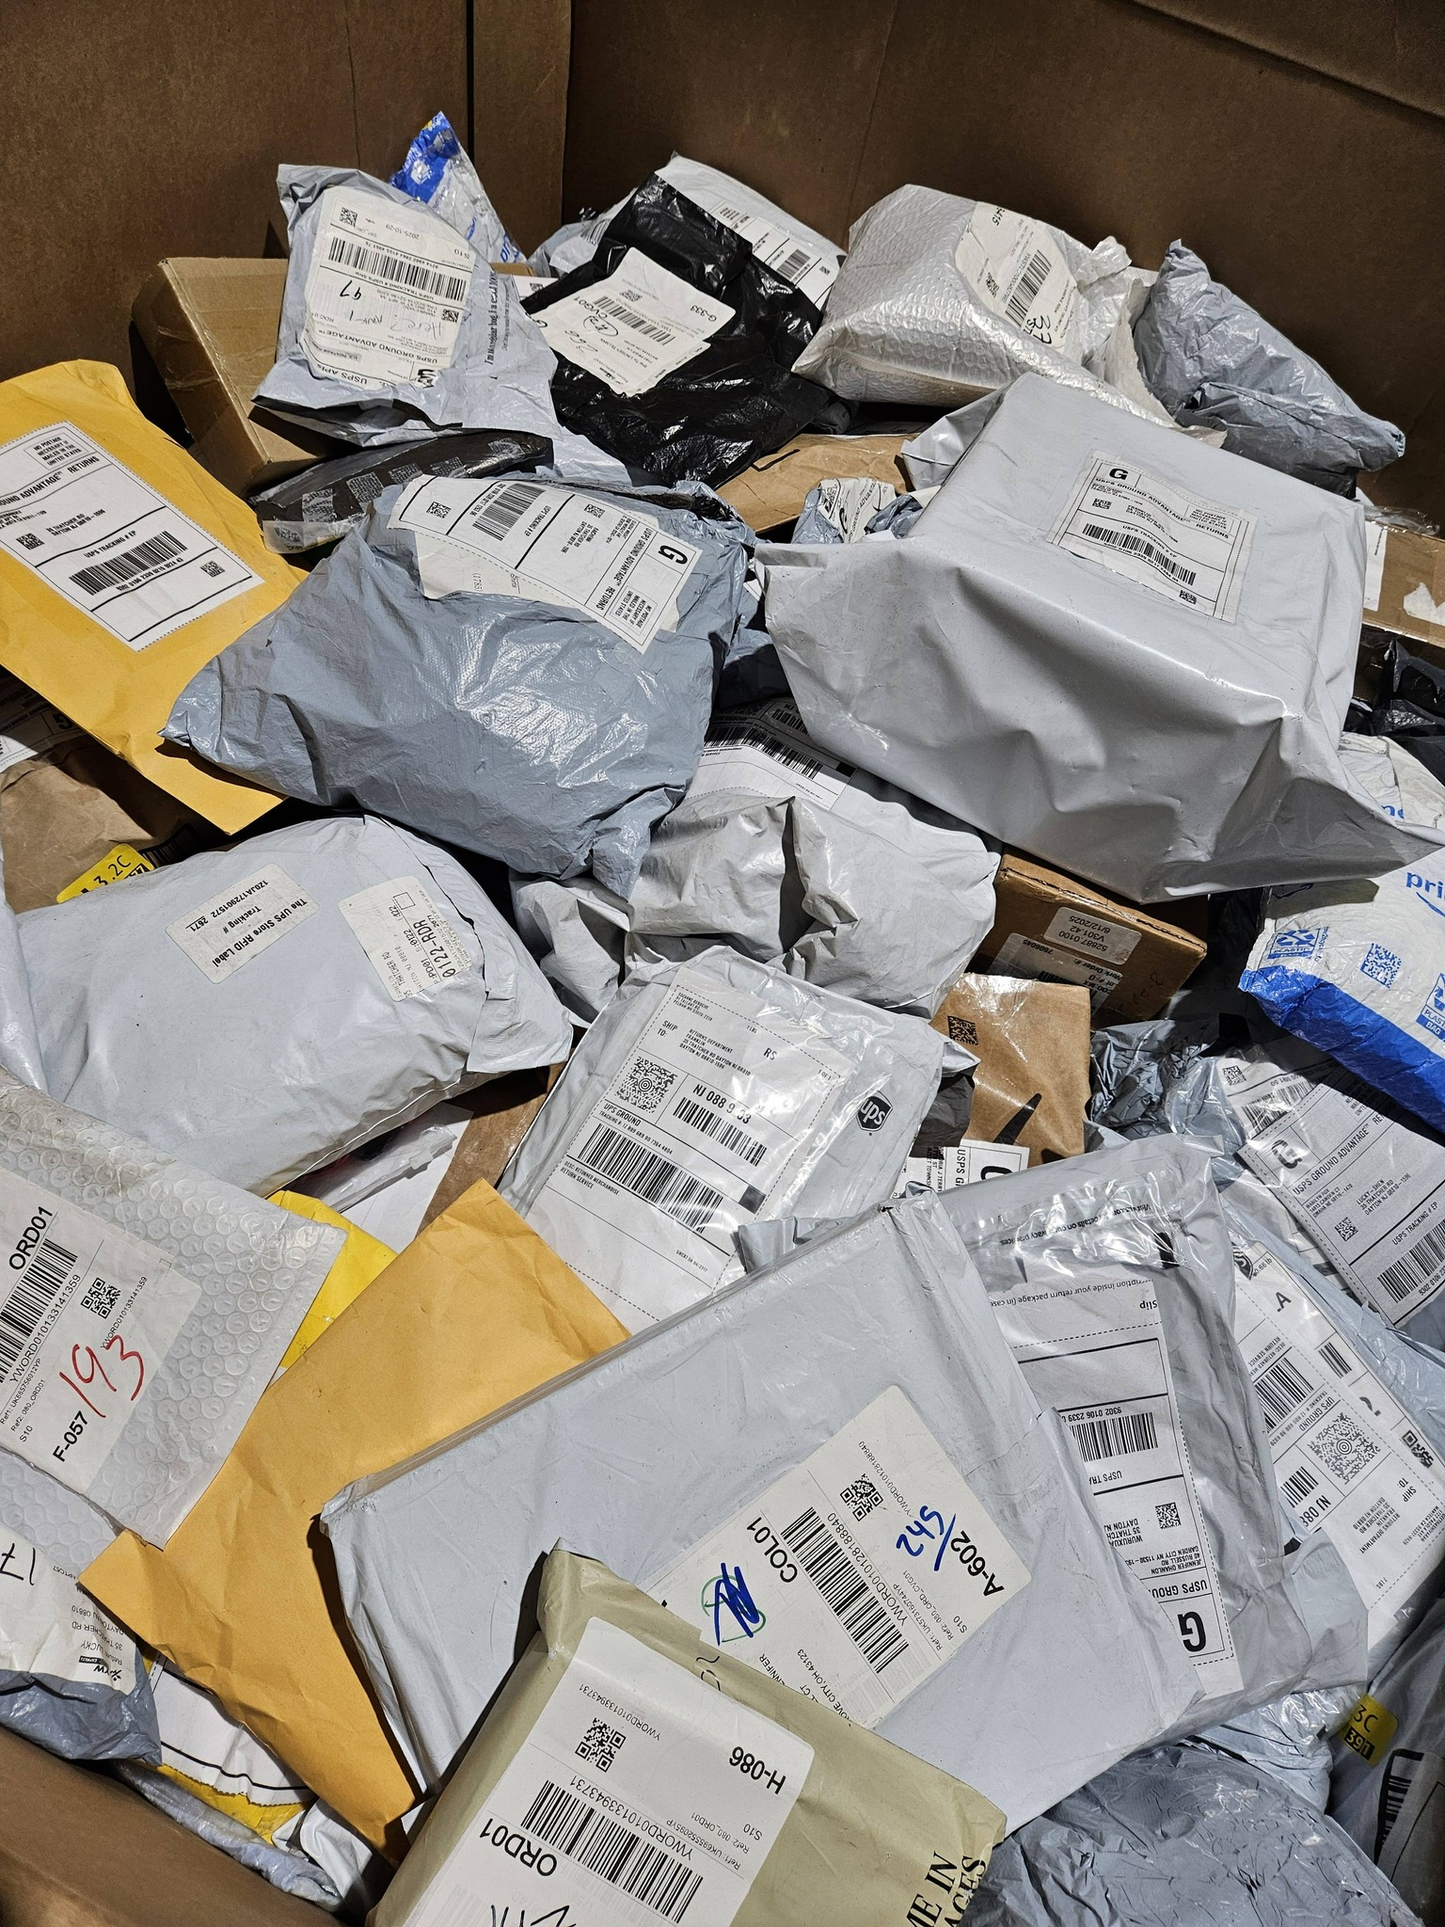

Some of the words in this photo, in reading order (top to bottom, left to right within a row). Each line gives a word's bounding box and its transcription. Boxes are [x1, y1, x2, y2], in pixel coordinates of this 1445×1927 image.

[339, 280, 361, 300] 97
[690, 305, 717, 322] G-333
[379, 344, 414, 358] GROUND
[416, 355, 437, 364] USPS
[340, 369, 368, 385] USPS
[47, 455, 65, 466] UNITED
[67, 456, 100, 473] RETURNS
[1109, 468, 1128, 480] G
[541, 505, 551, 515] USPS
[529, 514, 545, 529] TRACKING
[640, 528, 652, 540] USPS
[1196, 524, 1228, 539] RETURNS
[83, 549, 100, 558] USPS
[98, 537, 126, 552] TRACKING
[630, 539, 645, 557] GROUND
[658, 545, 688, 564] G
[596, 586, 615, 610] RETURNS
[623, 591, 633, 603] UNITED
[629, 595, 640, 608] MAILED
[615, 602, 626, 616] STATES
[622, 612, 630, 620] THE
[632, 599, 646, 620] NECESSARY
[636, 610, 649, 628] POSTAGE
[291, 898, 307, 909] The
[228, 906, 261, 928] Tracking
[274, 908, 292, 922] UPS
[221, 925, 229, 934] #
[253, 920, 275, 936] Store
[1070, 925, 1104, 942] V301.42
[234, 934, 254, 951] RFID
[413, 919, 456, 978] 0122-RDR
[1058, 931, 1108, 952] 52887.0100
[212, 948, 235, 967] Label
[382, 952, 391, 960] RD
[387, 960, 405, 986] THATCHER
[1082, 962, 1103, 974] Order
[657, 1028, 666, 1037] TO:
[662, 1020, 678, 1031] SHIP
[1426, 1020, 1441, 1035] BAG
[763, 1047, 777, 1060] RS
[693, 1084, 707, 1097] NJ
[706, 1091, 727, 1108] 088
[599, 1110, 618, 1123] TRACKING
[604, 1103, 617, 1113] UPS
[616, 1109, 641, 1126] GROUND
[860, 1098, 885, 1125] ups
[956, 1149, 966, 1174] USPS
[560, 1167, 577, 1179] RETURN
[576, 1175, 594, 1189] SERVICE
[1292, 1178, 1312, 1195] USPS
[1311, 1156, 1338, 1181] GROUND
[1364, 1185, 1388, 1205] THATCHER
[1385, 1178, 1394, 1189] RD
[1363, 1199, 1382, 1215] DAYTON
[1379, 1193, 1388, 1201] NJ
[1392, 1229, 1407, 1245] USPS
[1405, 1211, 1429, 1233] TRACKING
[1430, 1201, 1438, 1210] EP
[9, 1206, 53, 1270] ORD01
[1093, 1283, 1115, 1292] inside
[1429, 1273, 1441, 1285] 0106
[1018, 1292, 1048, 1303] package
[1050, 1290, 1073, 1298] return
[1074, 1286, 1091, 1294] your
[1139, 1300, 1158, 1310] Slip
[9, 1274, 81, 1382] YWORD010133141359
[59, 1334, 143, 1418] 193
[1321, 1396, 1335, 1410] UPS
[0, 1408, 13, 1425] Ref1:
[1086, 1409, 1103, 1418] 0106
[1299, 1407, 1323, 1431] GROUND
[10, 1416, 24, 1432] Ref2:
[19, 1425, 33, 1442] S10
[52, 1410, 88, 1462] F-057
[1099, 1470, 1122, 1483] USPS
[1397, 1478, 1409, 1488] TO:
[1316, 1495, 1331, 1510] NJ
[1402, 1486, 1416, 1502] SHIP
[1114, 1518, 1139, 1529] DAYTON
[1132, 1526, 1141, 1534] 35
[746, 1517, 798, 1583] COL01
[1170, 1553, 1192, 1563] RUSSELL
[827, 1513, 908, 1626] YWORD010128188840
[945, 1530, 1005, 1596] A-602
[1181, 1579, 1207, 1594] USPS
[71, 1621, 82, 1630] RD
[940, 1622, 954, 1640] Ref2:
[953, 1616, 967, 1633] S10
[1177, 1611, 1206, 1652] G
[114, 1642, 123, 1651] 35
[930, 1632, 943, 1651] Ref1:
[797, 1649, 814, 1671] 43123
[579, 1684, 660, 1741] YWORD010133943731
[729, 1746, 786, 1795] H-086
[570, 1775, 693, 1861] YWORD010133943731
[743, 1823, 762, 1841] S10
[479, 1818, 557, 1876] ORD01
[732, 1839, 750, 1854] Ref2:
[723, 1854, 741, 1870] Ref1:
[924, 1850, 957, 1894] IN
